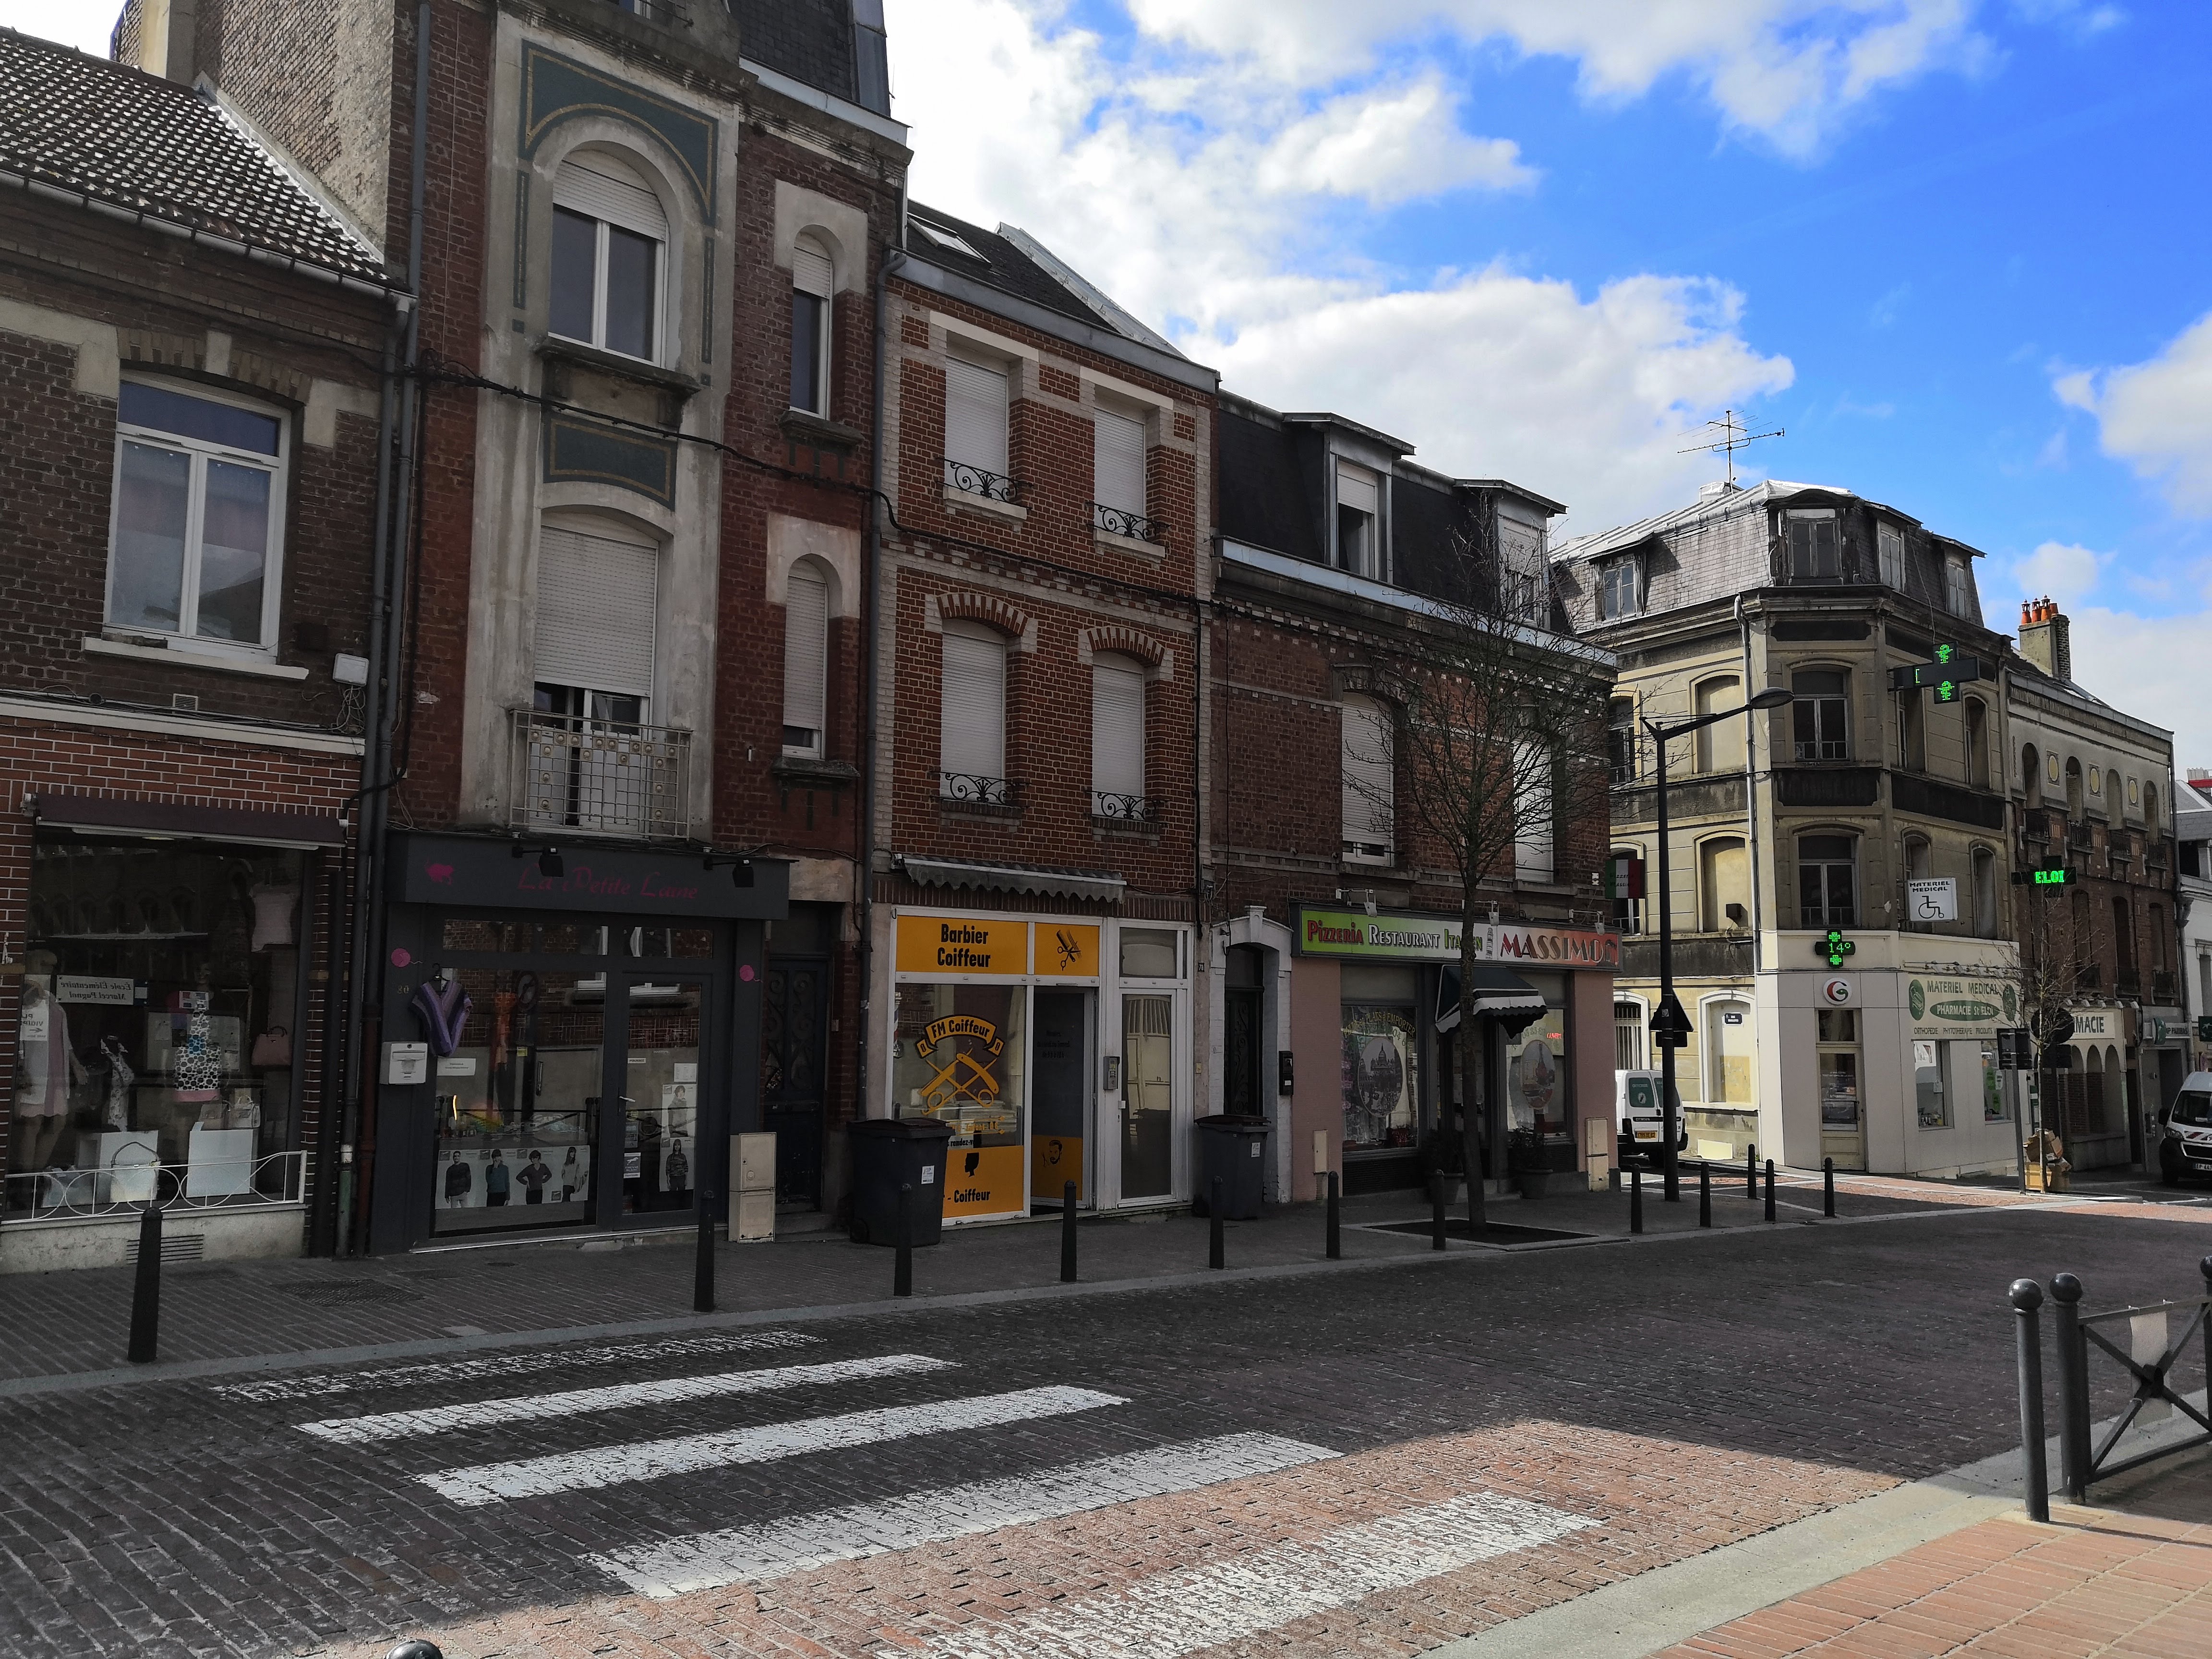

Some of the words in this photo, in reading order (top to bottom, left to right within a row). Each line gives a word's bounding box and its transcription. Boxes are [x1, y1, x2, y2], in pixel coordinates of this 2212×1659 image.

[562, 866, 631, 895] Petite
[2035, 870, 2065, 884] ELOI
[941, 924, 988, 944] Barbier
[937, 947, 991, 967] Coiffeur
[1500, 932, 1603, 964] MASSIMO
[1927, 980, 1963, 993] MATERIEL
[1968, 982, 1999, 995] MEDICAL
[1936, 1005, 1971, 1015] PHARMACIE
[1973, 1006, 1979, 1015] St
[931, 1022, 946, 1038] FM
[949, 1019, 990, 1037] Coiffeur
[1387, 1013, 1416, 1037] EMPORTER
[2074, 1016, 2104, 1033] MACIE
[950, 1138, 974, 1147] rendez-v
[954, 1188, 990, 1203] Coiffeur
